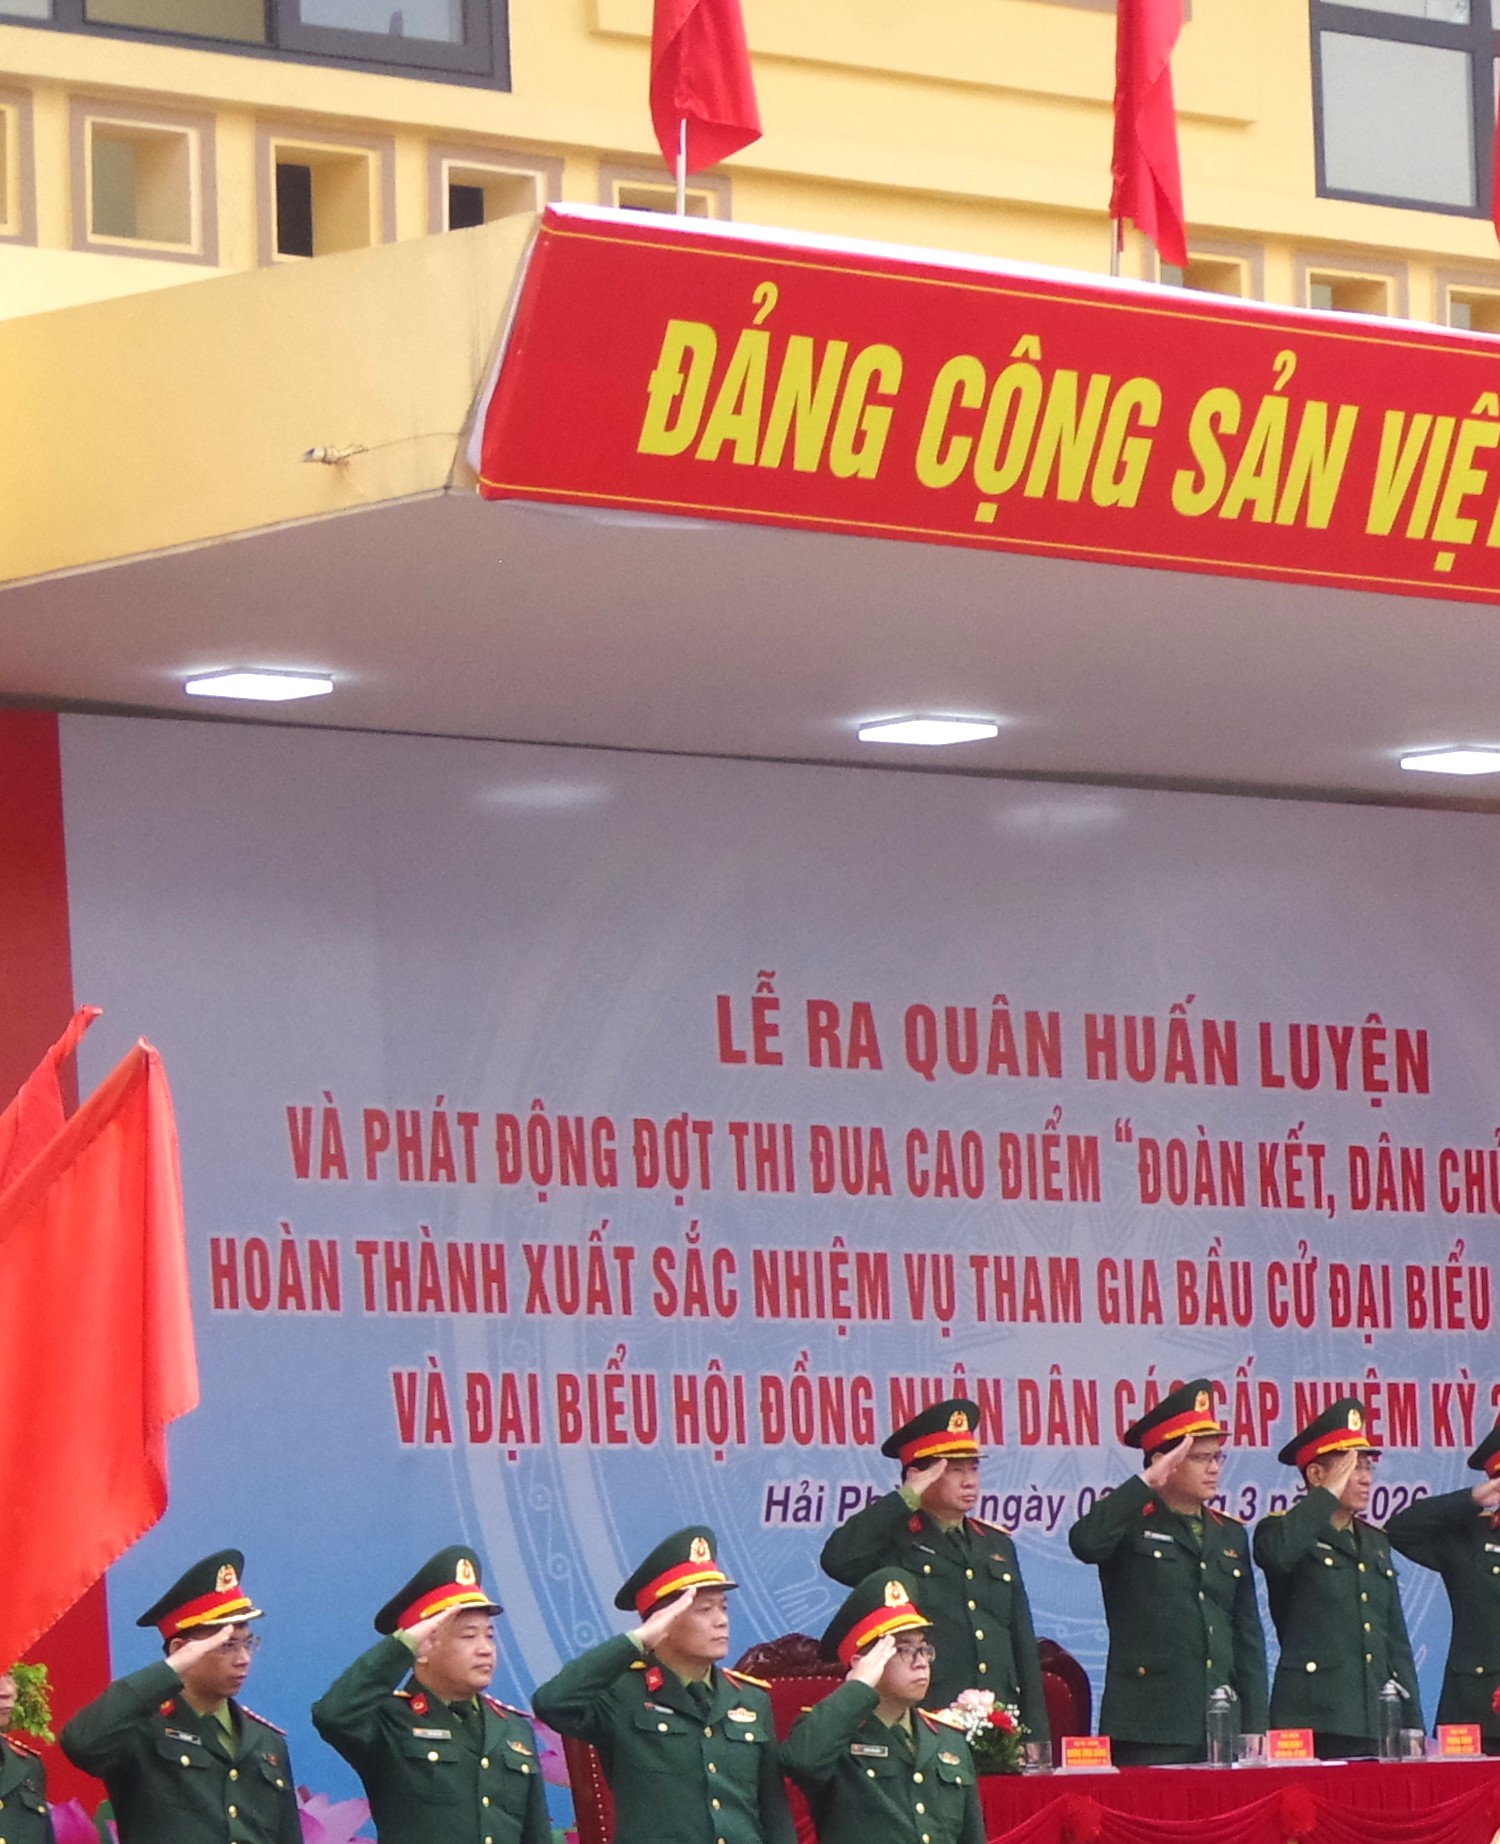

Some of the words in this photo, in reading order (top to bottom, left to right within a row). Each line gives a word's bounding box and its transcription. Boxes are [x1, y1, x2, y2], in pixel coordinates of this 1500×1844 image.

[638, 282, 902, 478] ĐẢNG
[916, 335, 1162, 523] CỘNG
[1172, 350, 1359, 528] SẢN
[716, 971, 784, 1066] LỄ
[807, 999, 883, 1070] RA
[904, 993, 1062, 1082] QUÂN
[1085, 994, 1239, 1086] HUẤN
[1259, 1013, 1430, 1108] LUYỆN
[287, 1092, 348, 1180] VÀ
[364, 1096, 480, 1183] PHÁT
[495, 1099, 619, 1202] ĐỘNG
[633, 1113, 713, 1206] ĐỢT
[728, 1122, 796, 1192] THI
[810, 1125, 892, 1196] ĐUA
[905, 1128, 986, 1199] CAO
[999, 1106, 1101, 1202] ĐIỂM
[1115, 1116, 1246, 1207] “ĐOÀN
[1258, 1123, 1337, 1220] KẾT,
[1348, 1132, 1427, 1212] DÂN
[210, 1223, 341, 1312] HOÀN
[356, 1226, 508, 1313] THÀNH
[523, 1221, 635, 1316] XUẤT
[652, 1213, 738, 1318] SẮC
[752, 1237, 892, 1336] NHIỆM
[904, 1253, 956, 1337] VỤ
[969, 1255, 1082, 1323] THAM
[1096, 1258, 1164, 1324] GIA
[1176, 1238, 1253, 1327] BẦU
[1267, 1240, 1319, 1328] CỬ
[1329, 1263, 1393, 1344] ĐẠI
[1405, 1240, 1492, 1331] BIỂU
[393, 1357, 452, 1444] VÀ
[466, 1372, 541, 1460] ĐẠI
[557, 1344, 657, 1445] BIỂU
[674, 1360, 746, 1461] HỘI
[760, 1349, 876, 1445] ĐỒNG
[1017, 1364, 1100, 1446] DÂN
[1114, 1366, 1186, 1447] CÁ
[1210, 1357, 1280, 1448] CẤP
[1294, 1368, 1419, 1463] NỆM
[1431, 1370, 1477, 1447] KỲ
[765, 1481, 824, 1522] Hải
[980, 1485, 1068, 1531] ngày
[1240, 1487, 1260, 1521] 3
[1353, 1485, 1428, 1522] 026
